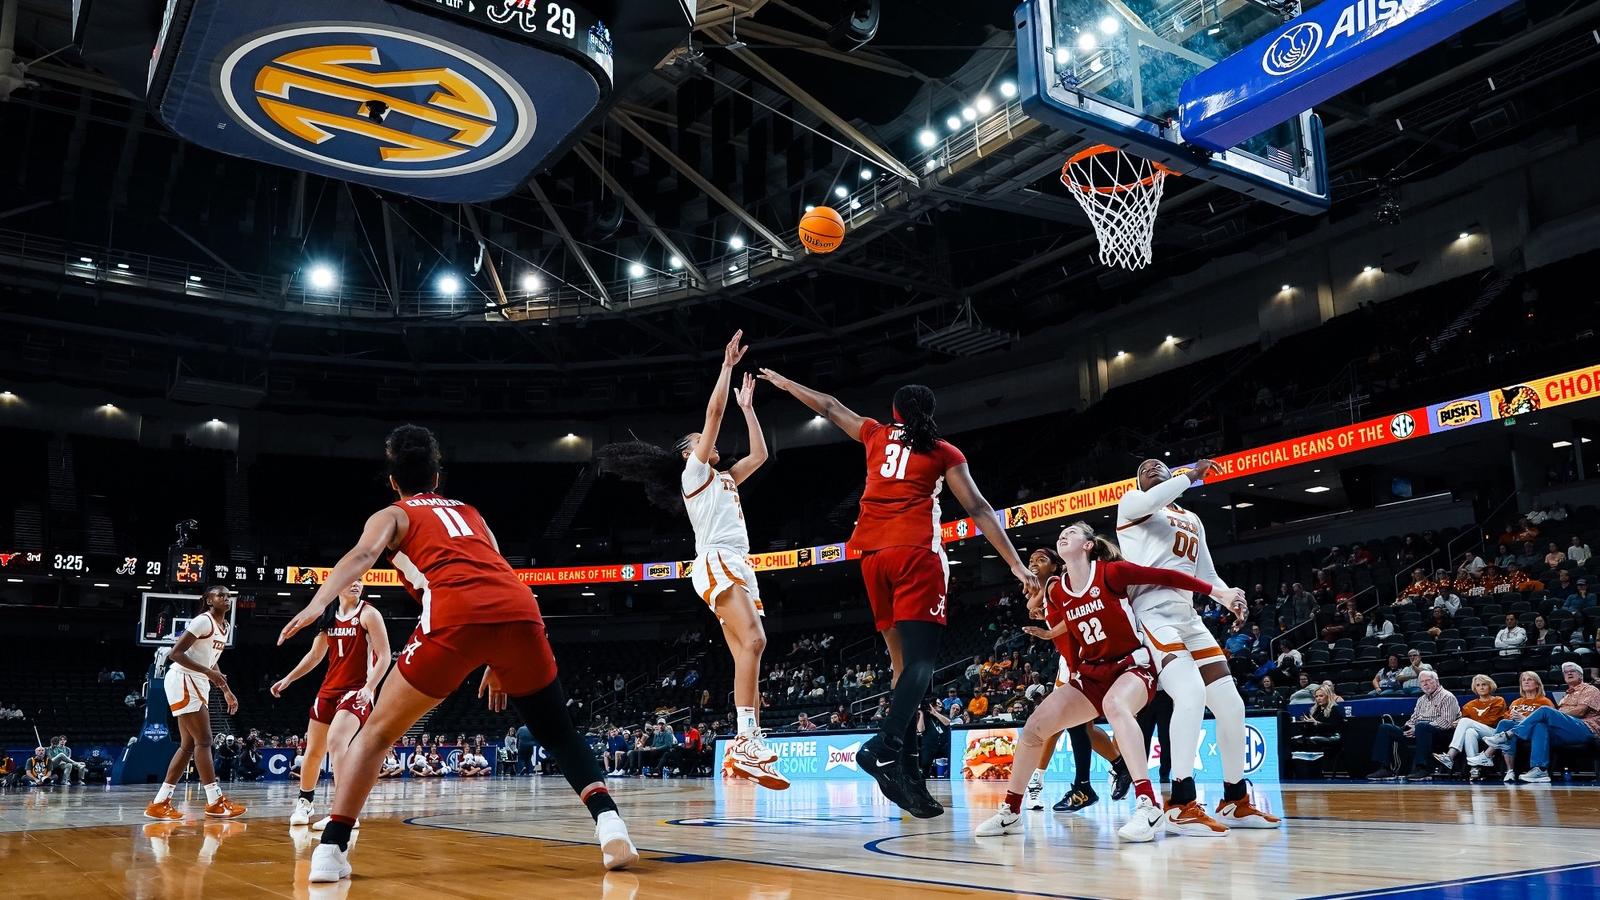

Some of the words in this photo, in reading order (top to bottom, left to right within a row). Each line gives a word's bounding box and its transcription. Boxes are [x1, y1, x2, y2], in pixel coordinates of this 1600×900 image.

[546, 3, 576, 39] 29
[1325, 0, 1402, 48] Alls
[804, 233, 834, 248] Wilson
[1440, 403, 1479, 424] BUSH'S
[1237, 447, 1290, 471] OFFICIAL
[1292, 436, 1335, 459] BEANS
[1338, 431, 1355, 449] OF
[1358, 424, 1385, 443] THE
[1390, 413, 1415, 440] SEC
[880, 443, 912, 480] 31
[1069, 491, 1096, 511] CHILI
[432, 507, 474, 538] 11
[1172, 530, 1199, 563] 00
[1307, 535, 1321, 545] 114
[27, 553, 41, 562] 3rd
[54, 554, 83, 570] 3:25
[182, 554, 204, 565] 3:25
[821, 547, 840, 558] BUSH'S
[146, 561, 161, 575] 29
[365, 572, 392, 582] CHILI
[518, 571, 555, 582] OFFICIAL
[558, 570, 586, 581] BEANS
[588, 569, 599, 580] OF
[601, 568, 617, 579] THE
[1066, 599, 1105, 621] ALABAMA
[1077, 617, 1108, 645] 22
[337, 638, 344, 658] 1
[790, 741, 817, 757] FREE
[830, 751, 856, 763] SONIC
[784, 757, 818, 774] SONIC
